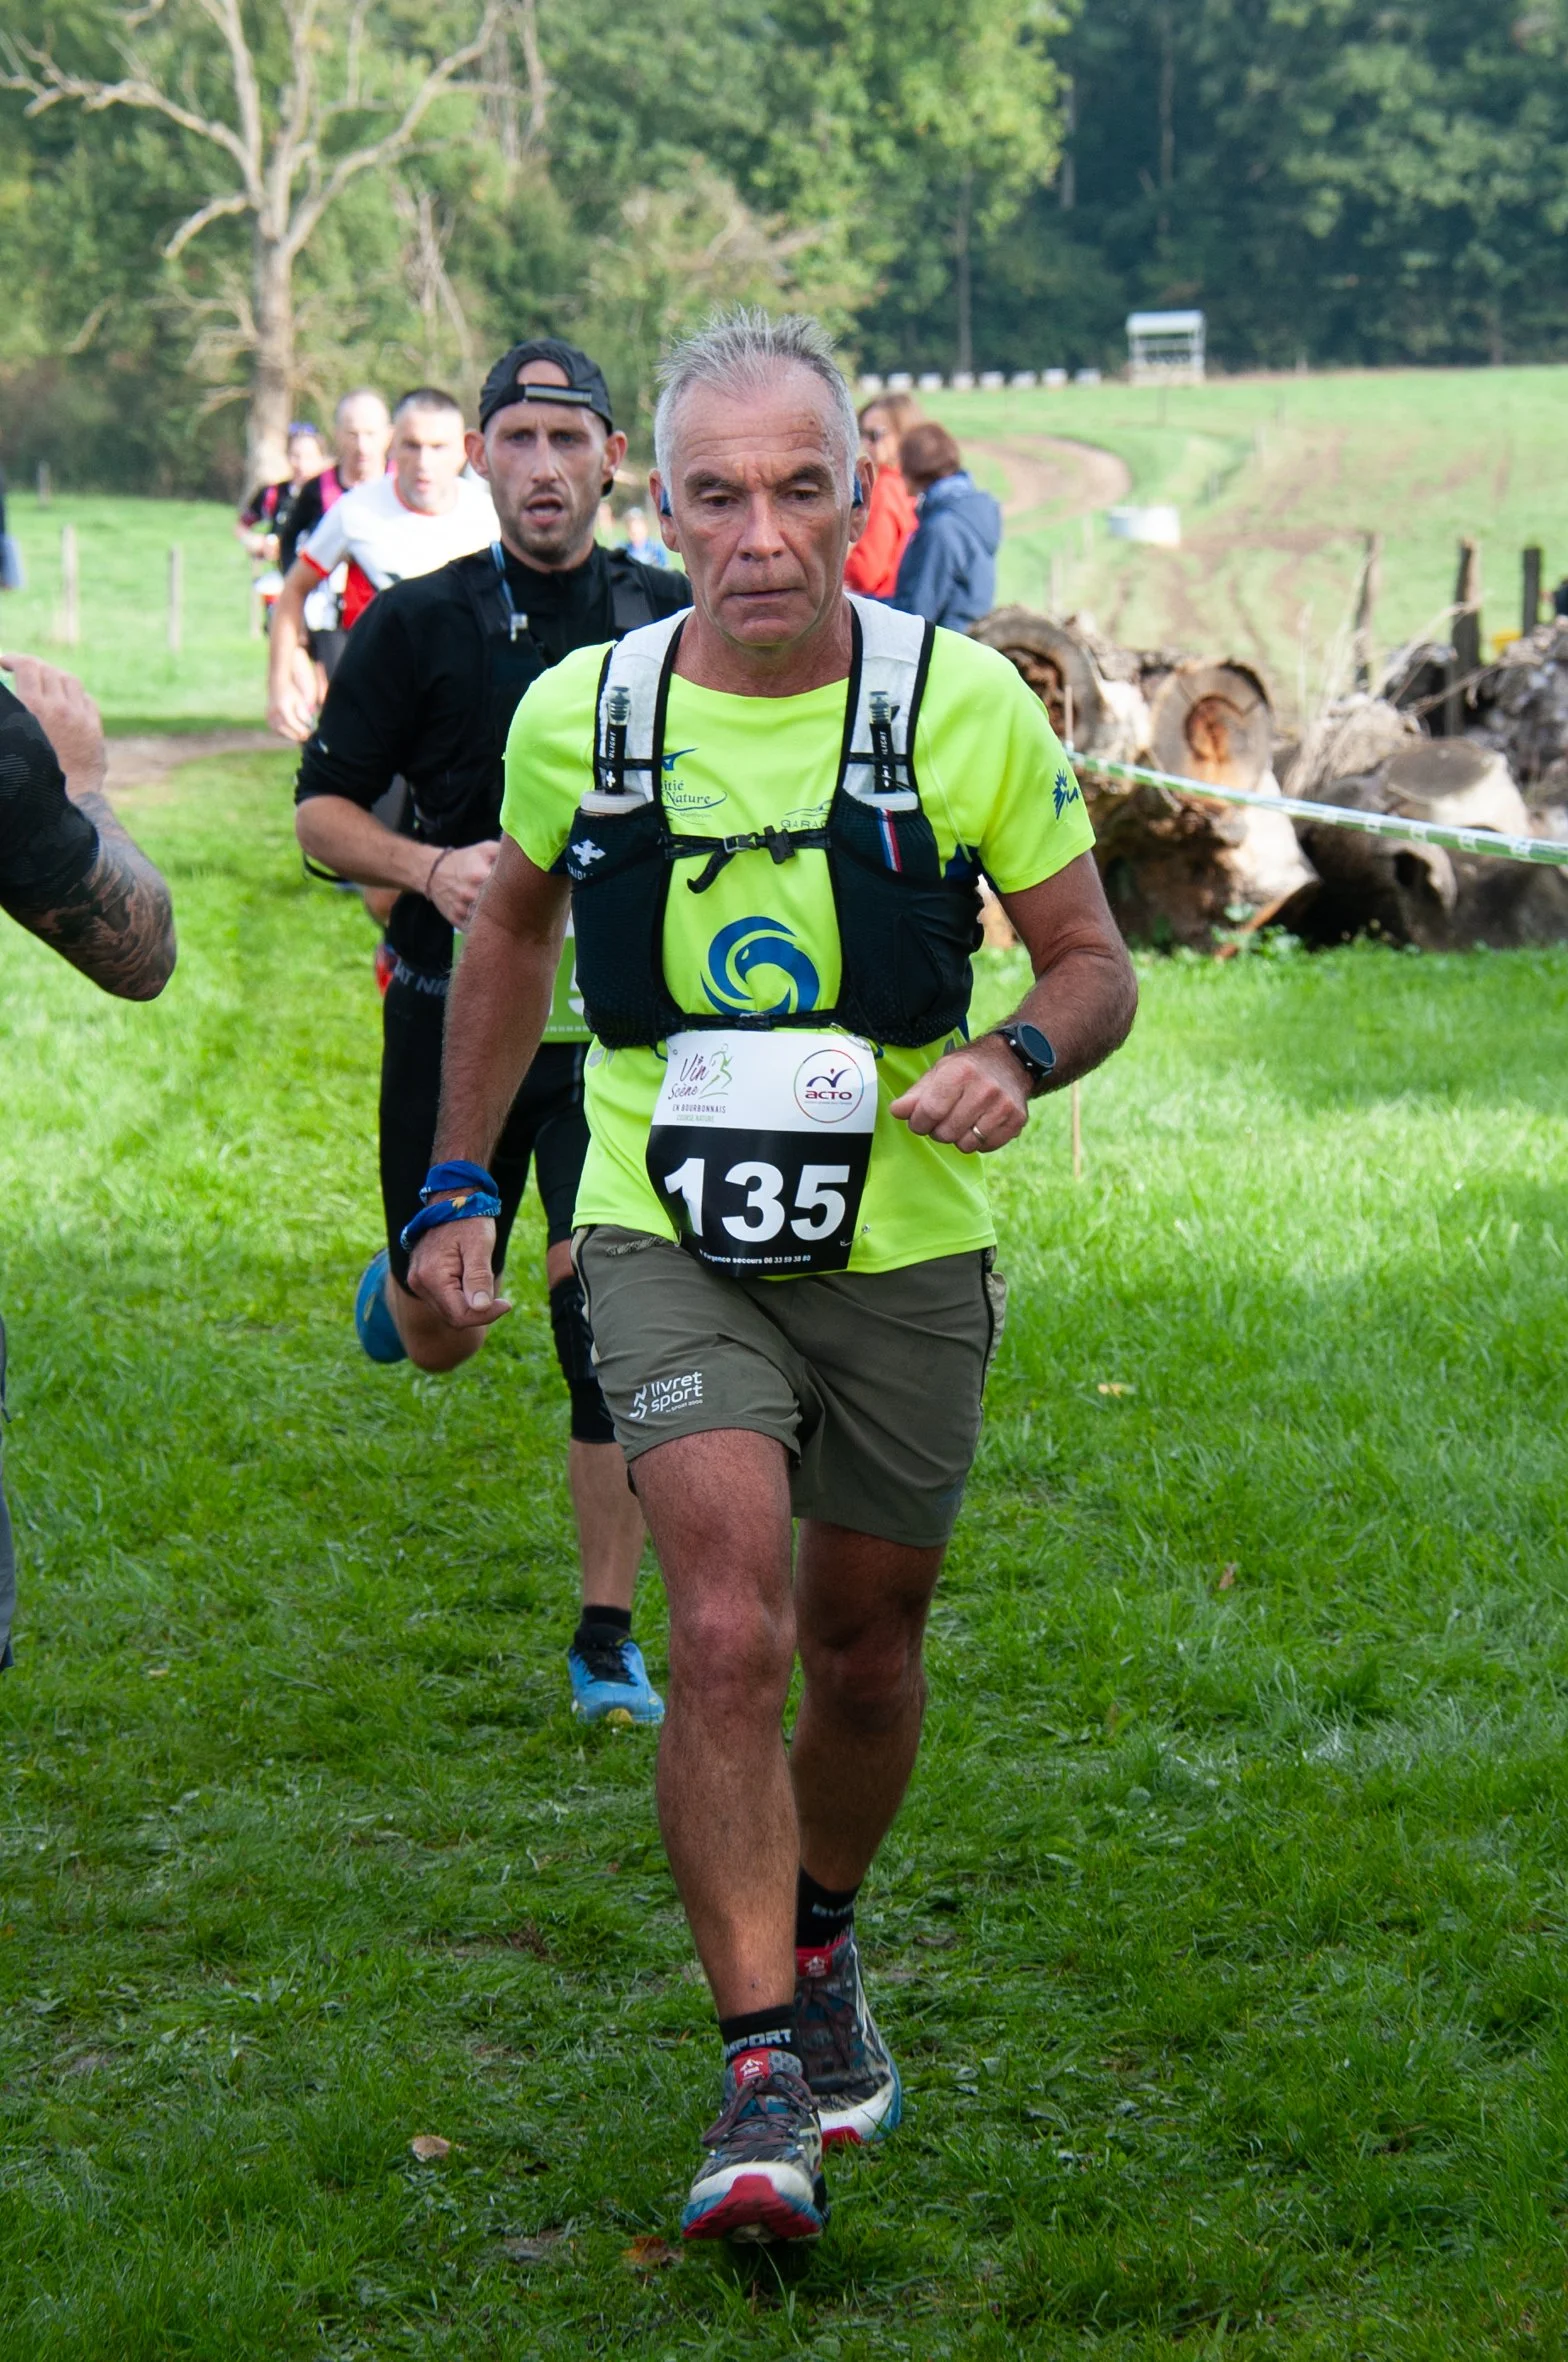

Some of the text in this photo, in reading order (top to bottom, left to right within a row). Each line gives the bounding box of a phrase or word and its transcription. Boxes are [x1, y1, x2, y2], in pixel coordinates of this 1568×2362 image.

[664, 779, 684, 791] itié
[665, 790, 711, 807] Nature
[680, 1053, 709, 1082] Vin
[681, 1104, 726, 1114] BOURBONNAIS
[664, 1158, 850, 1242] 135
[651, 1371, 703, 1397] livret
[651, 1385, 703, 1412] sport
